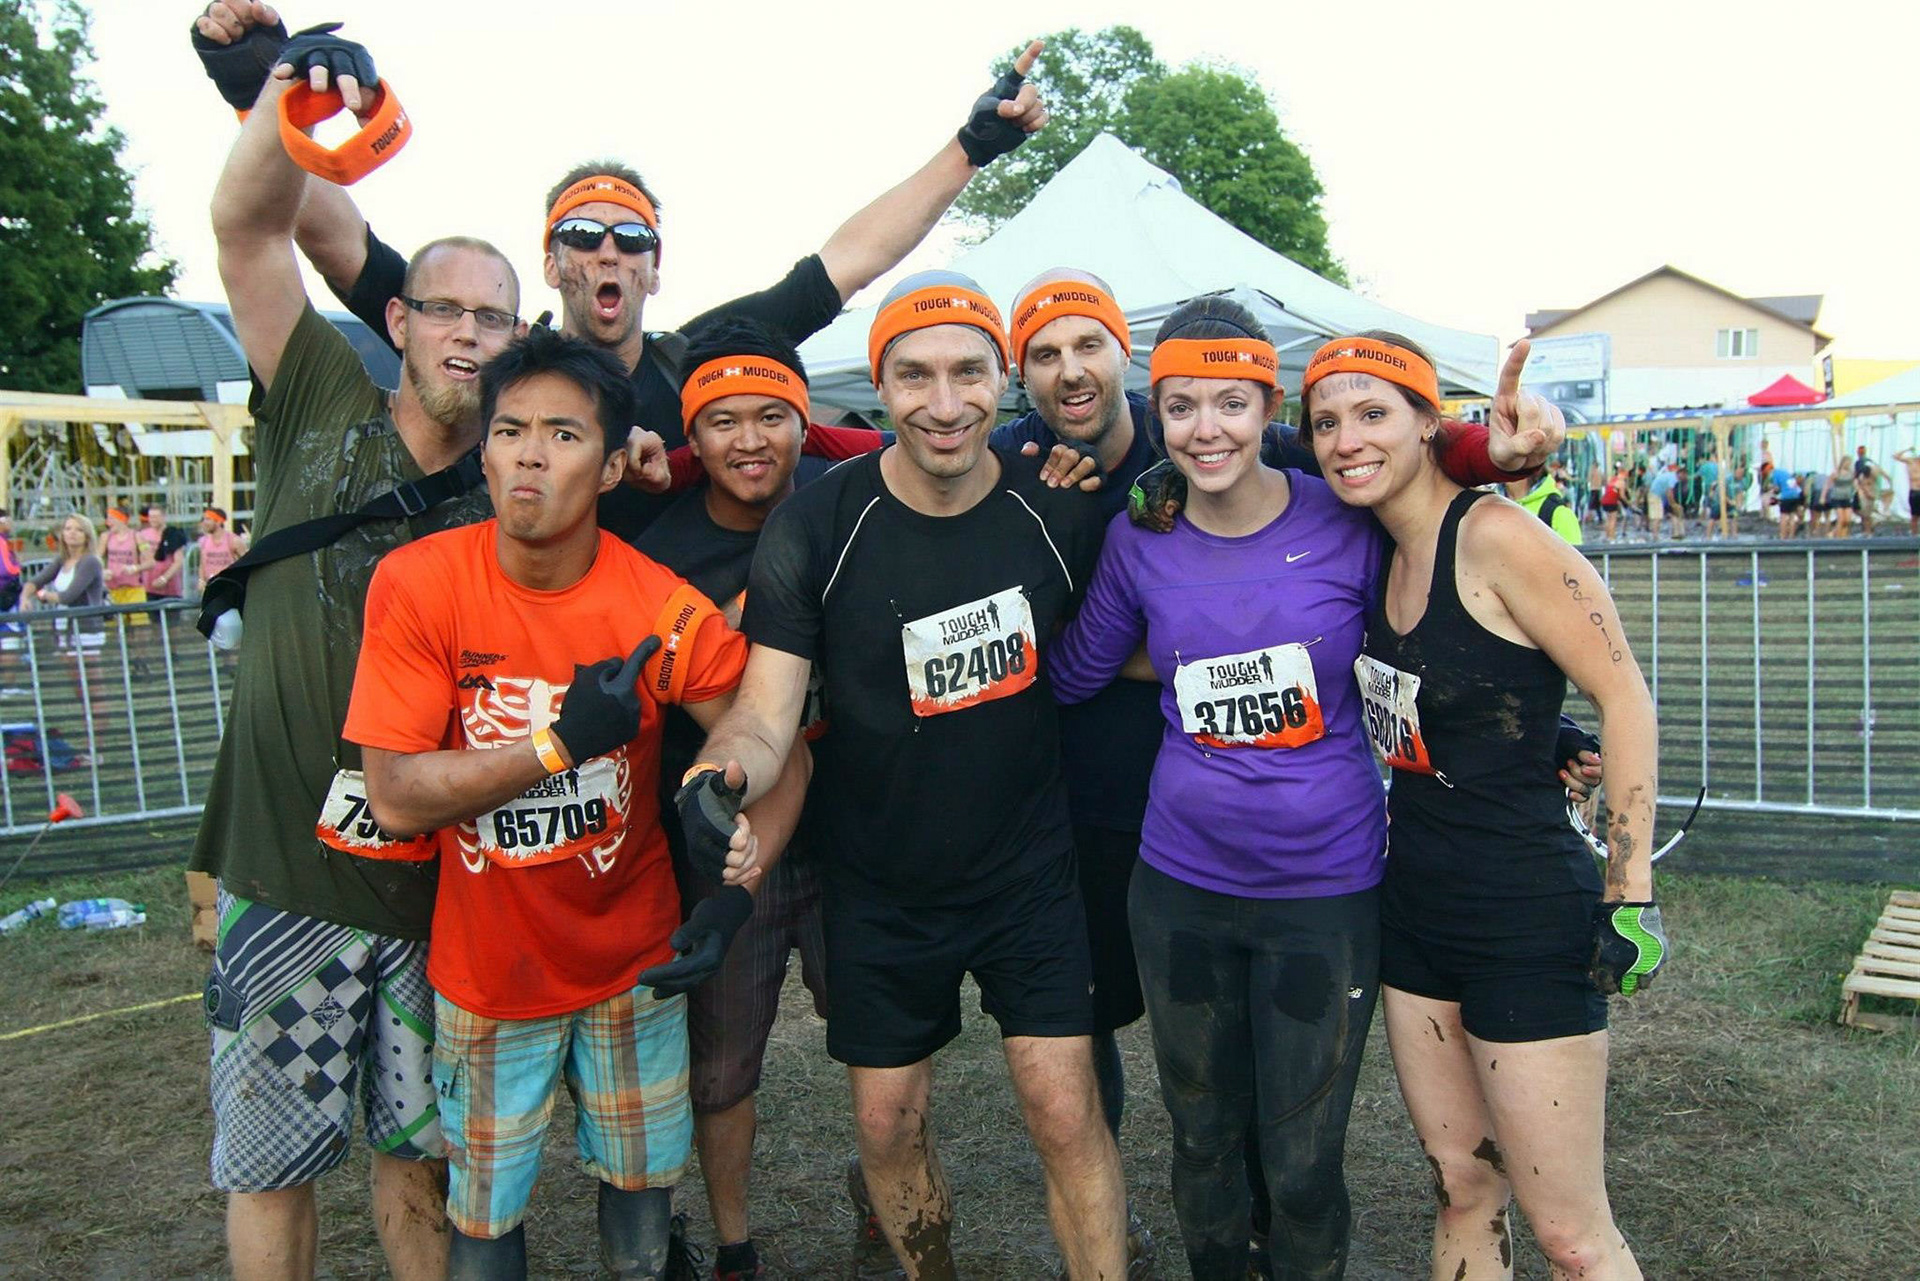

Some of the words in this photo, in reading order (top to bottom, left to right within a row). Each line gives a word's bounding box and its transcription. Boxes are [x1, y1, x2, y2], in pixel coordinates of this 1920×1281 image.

[370, 121, 401, 155] TOUGH
[914, 297, 951, 313] TOUGH
[1017, 304, 1038, 330] TOUGH
[1052, 291, 1100, 306] MUDDER
[1202, 350, 1238, 363] TOUGH
[1354, 348, 1407, 371] MUDDER
[697, 368, 723, 388] TOUGH
[742, 366, 789, 386] MUDDER
[672, 603, 697, 634] TOUGH
[938, 609, 988, 635] TOUGH
[942, 623, 991, 646] MUDDER
[656, 649, 676, 692] MUDDER
[924, 632, 1026, 698] 62408
[1207, 660, 1259, 680] TOUGH
[1209, 674, 1262, 690] MUDDER
[1194, 687, 1307, 736] 37656
[493, 798, 607, 849] 65709
